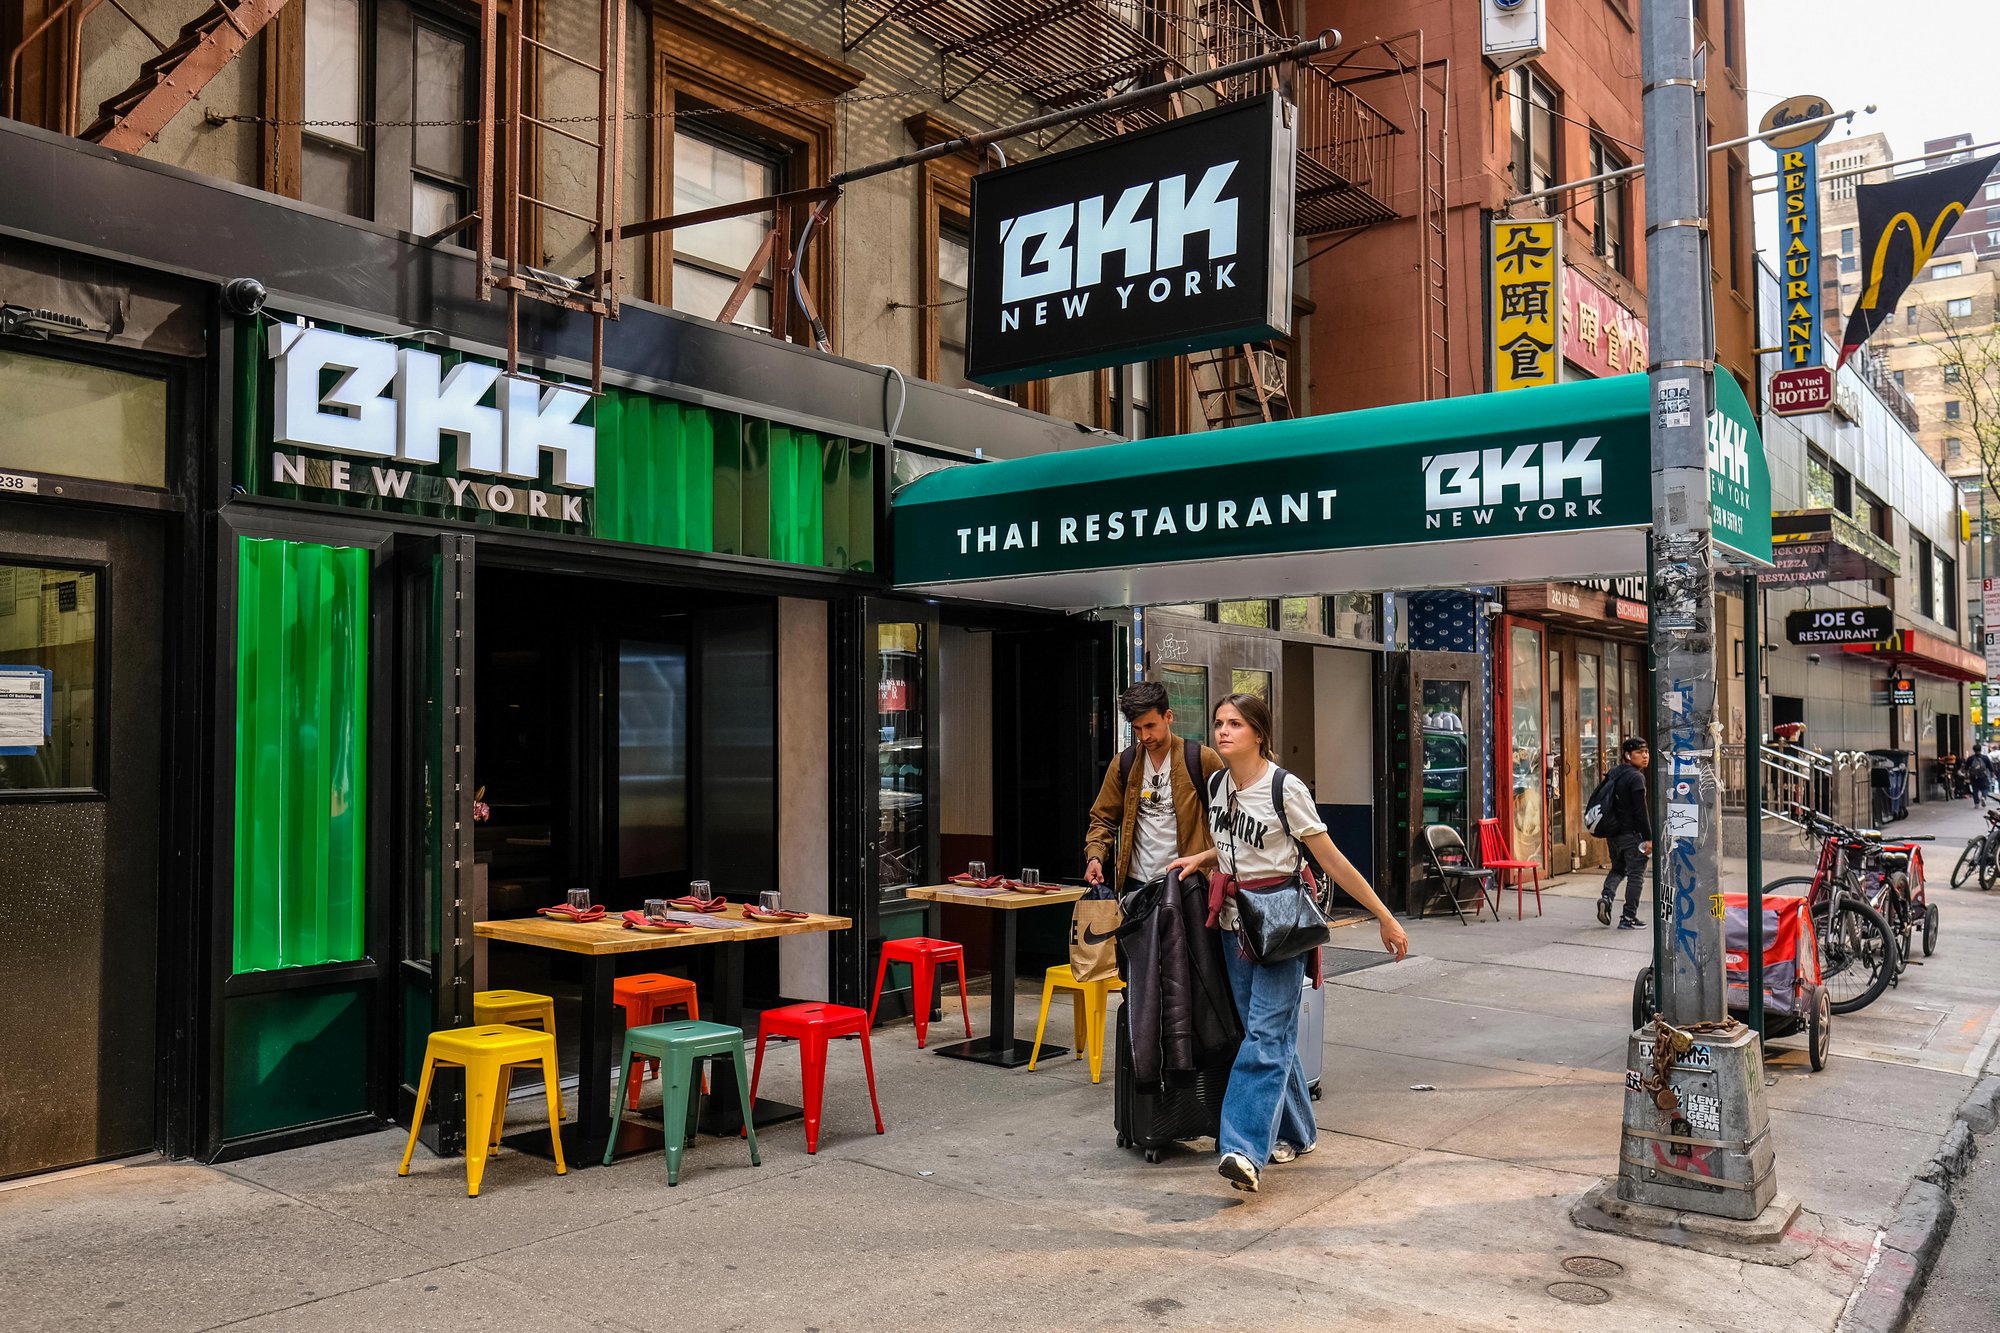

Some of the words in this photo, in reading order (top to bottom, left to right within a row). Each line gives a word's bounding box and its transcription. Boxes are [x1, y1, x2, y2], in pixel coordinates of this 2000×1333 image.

[999, 159, 1240, 305] BKK
[1782, 151, 1812, 364] RESTAURANT
[1000, 292, 1091, 334] NEW
[1116, 261, 1238, 310] YORK
[1496, 226, 1554, 389] 朵頤食
[1779, 381, 1794, 391] Da
[1797, 376, 1824, 388] Vinci
[268, 322, 596, 490] BKK
[1774, 387, 1830, 406] HOTEL
[1421, 435, 1604, 512] BKK
[272, 452, 412, 499] NEW
[447, 476, 584, 524] YORK
[1711, 473, 1724, 496] EW
[1728, 485, 1750, 511] YORK
[956, 519, 1041, 556] THAI
[1059, 489, 1338, 546] RESTAURANT
[1424, 506, 1495, 531] NEW
[1513, 497, 1605, 524] YORK
[1794, 545, 1825, 555] OVEN
[1776, 559, 1809, 569] PIZZA
[1758, 570, 1827, 583] RESTAURANT
[1552, 589, 1562, 605] 242
[1562, 593, 1568, 607] W
[1617, 601, 1646, 619] SICHUAN
[1812, 611, 1847, 629] JOE
[1851, 610, 1865, 626] G
[1798, 628, 1880, 643] RESTAURANT
[1216, 841, 1238, 853] CITY
[1686, 1110, 1720, 1125] GENE
